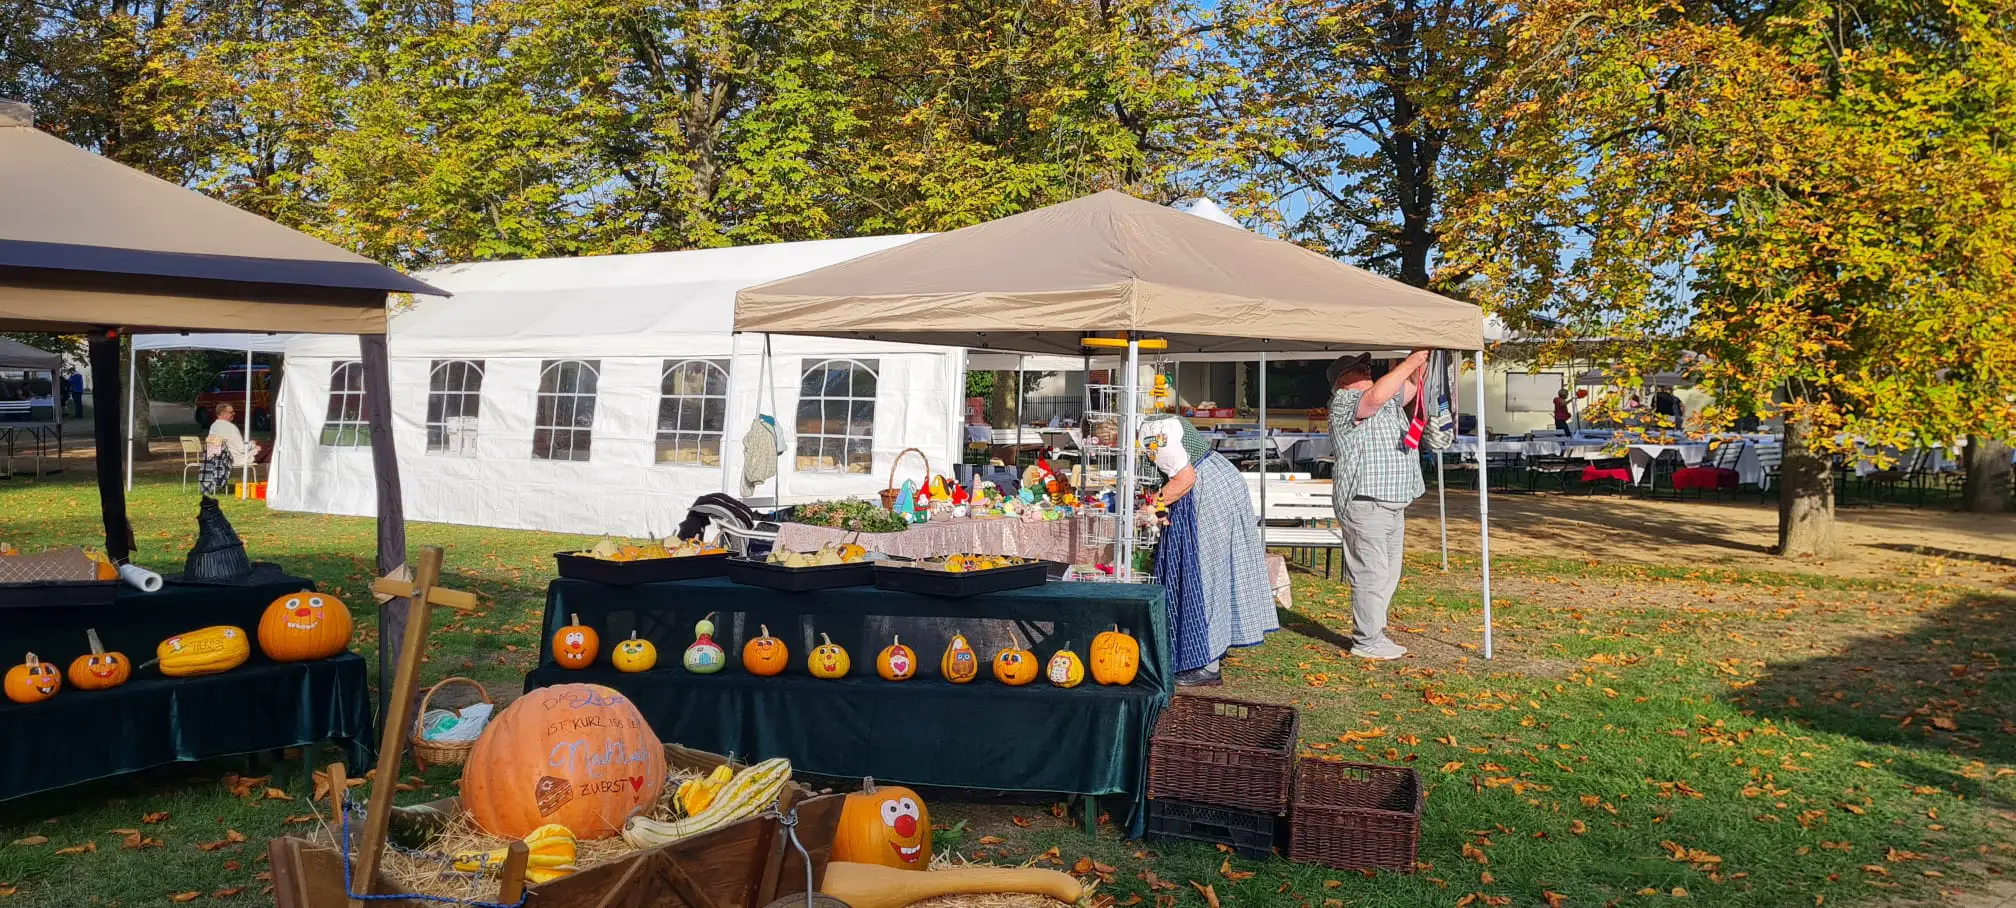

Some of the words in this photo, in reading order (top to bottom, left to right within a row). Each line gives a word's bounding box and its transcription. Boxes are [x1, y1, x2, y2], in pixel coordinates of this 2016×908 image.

[542, 691, 577, 711] DAS
[546, 719, 569, 737] IST
[572, 715, 606, 730] KURZ
[578, 779, 628, 797] ZUERST
